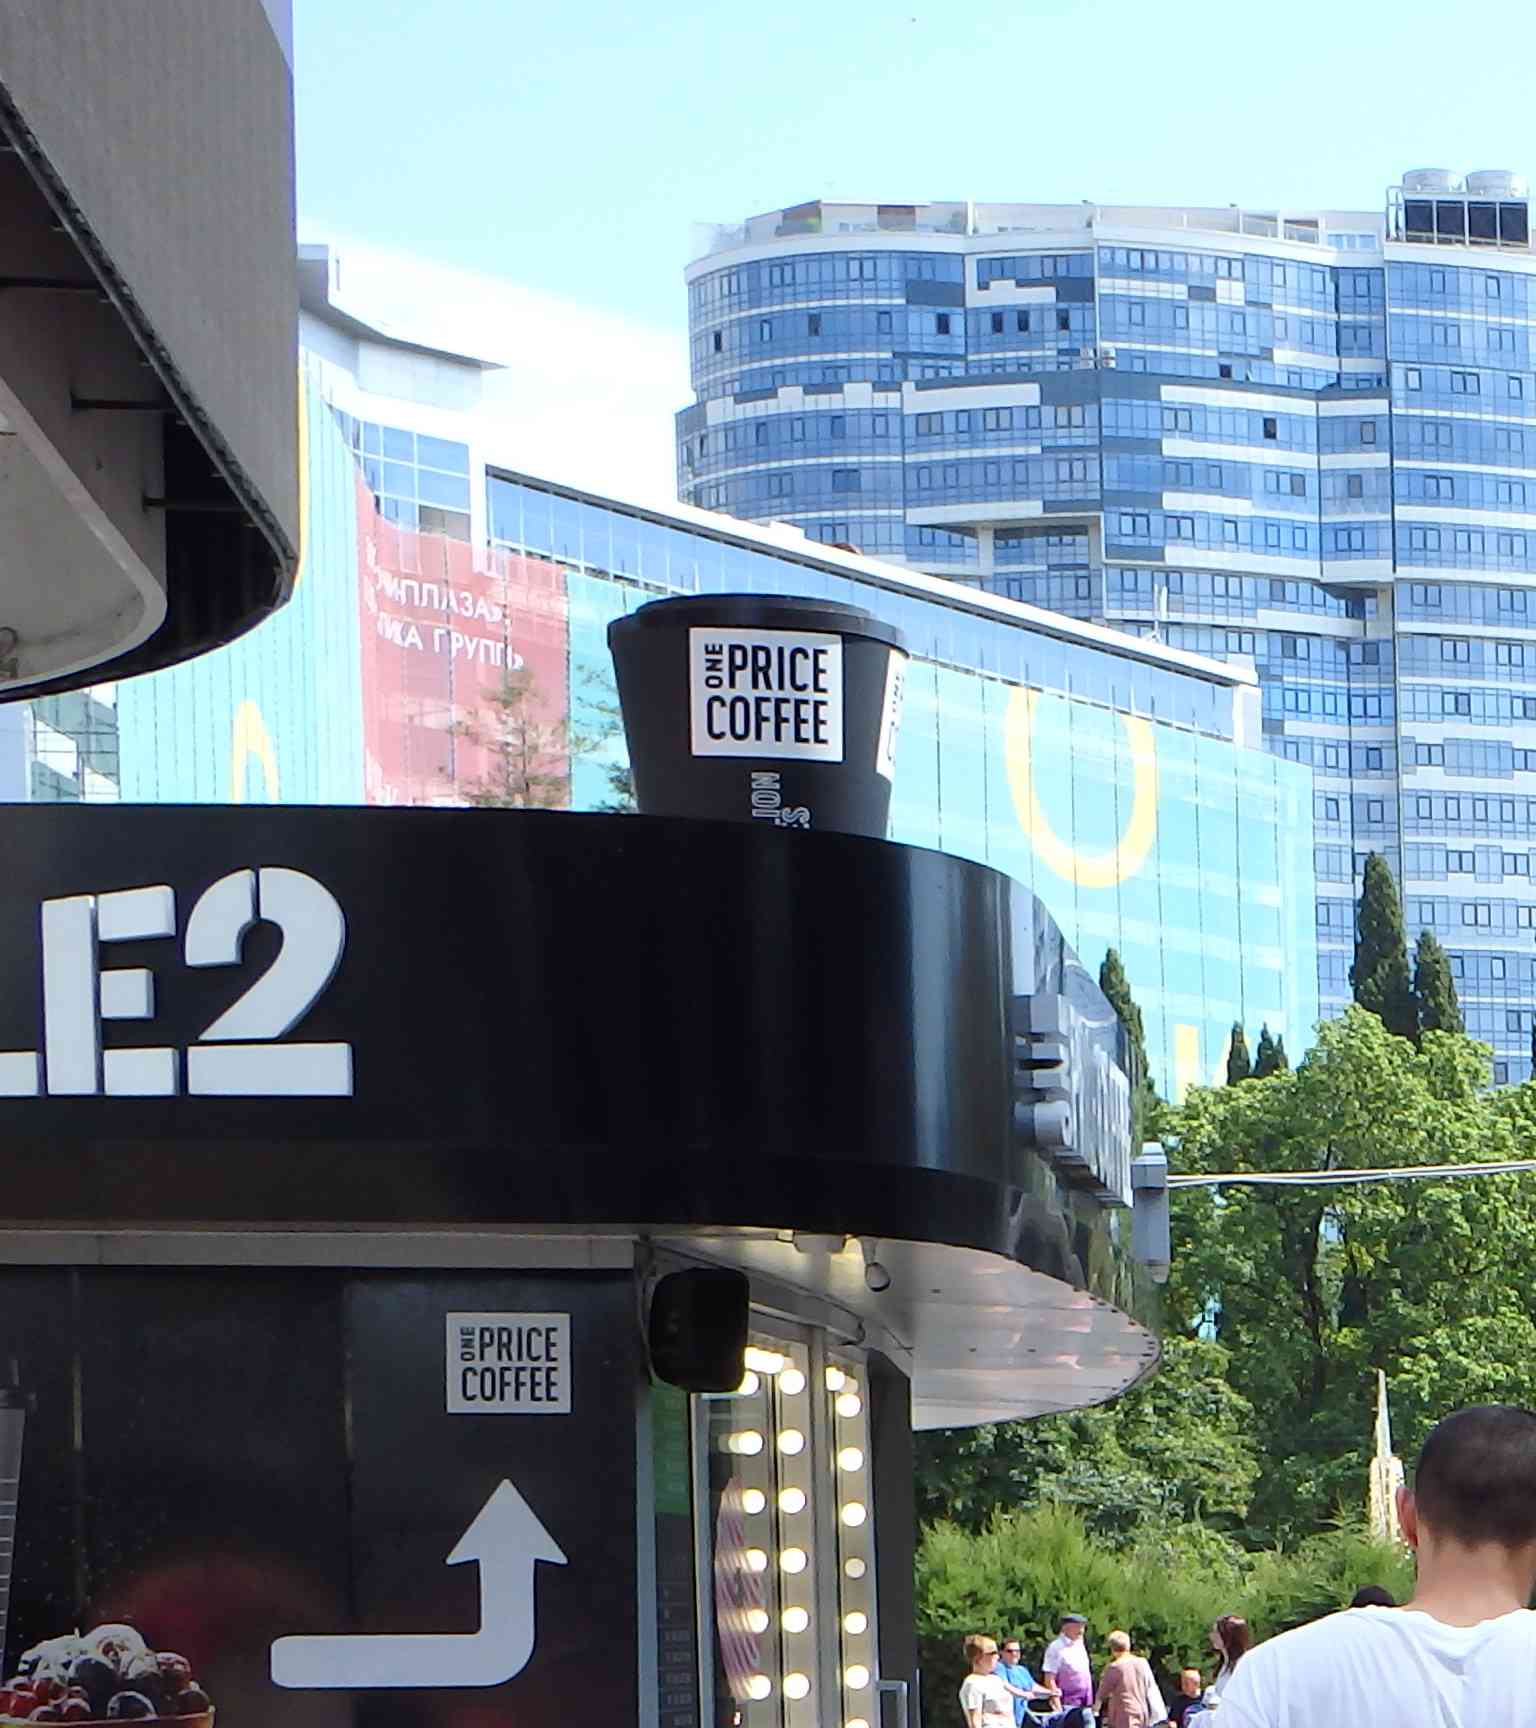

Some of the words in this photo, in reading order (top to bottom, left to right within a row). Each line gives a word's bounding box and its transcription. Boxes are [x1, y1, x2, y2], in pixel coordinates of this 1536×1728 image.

[704, 643, 723, 689] ONE
[728, 643, 829, 694] PRICE
[706, 695, 829, 745] COFFEE
[0, 866, 354, 1098] E2
[460, 1327, 475, 1362] ONE
[479, 1326, 559, 1362] PRICE
[462, 1366, 559, 1402] COFFEE
